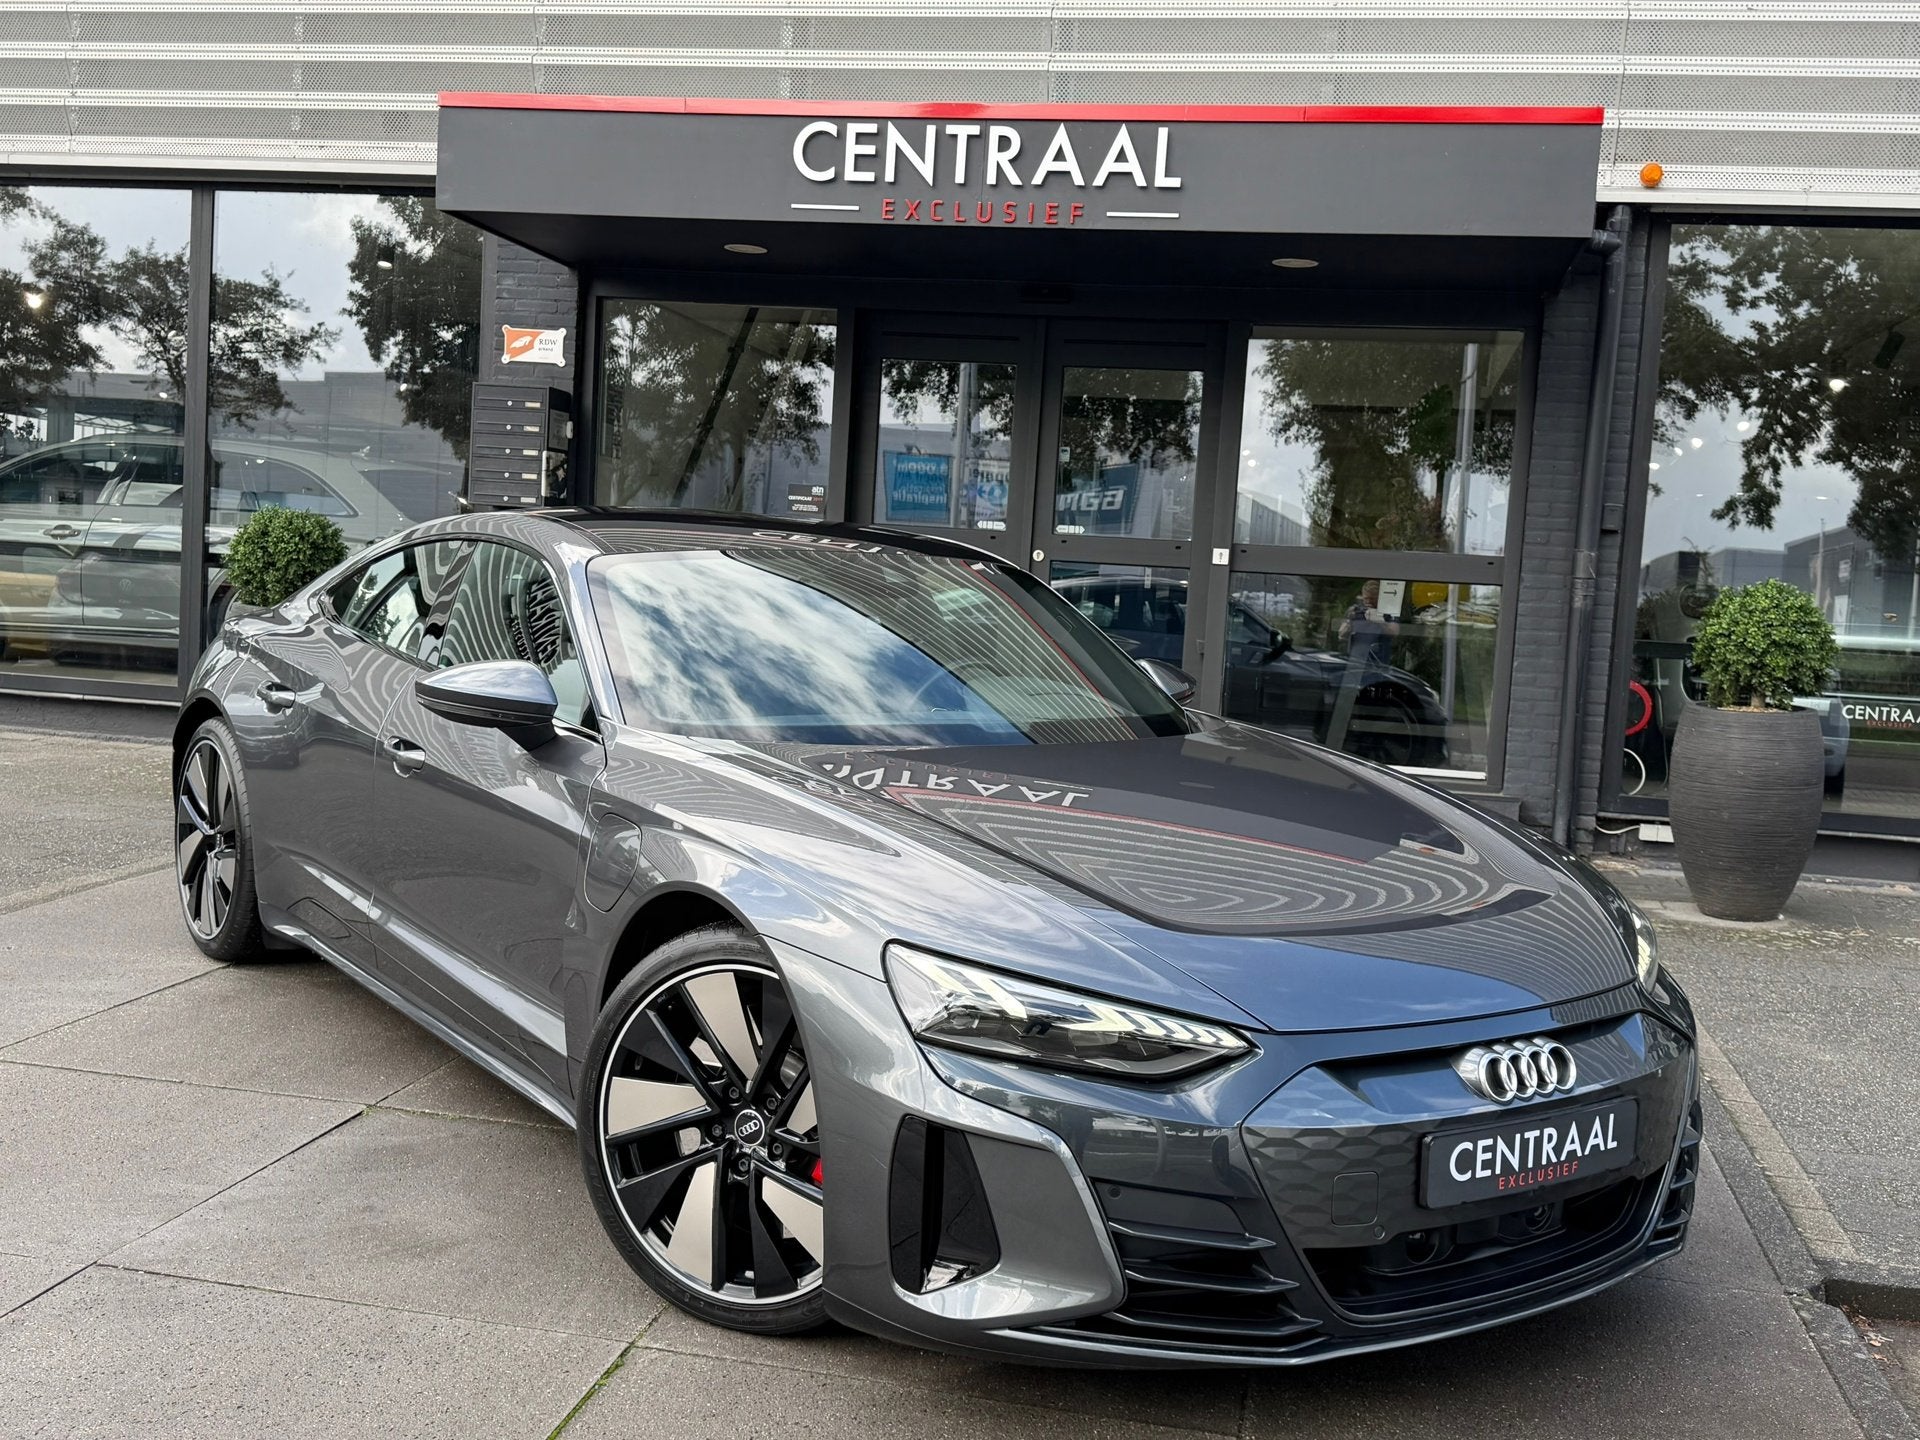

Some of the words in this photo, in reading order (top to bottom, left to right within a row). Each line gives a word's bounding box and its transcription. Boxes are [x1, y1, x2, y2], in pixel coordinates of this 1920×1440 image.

[792, 120, 1182, 188] CENTRAAL
[881, 198, 1085, 224] EXCLUSIEF
[538, 338, 558, 346] RDW
[1842, 704, 1920, 723] CENTRA
[1450, 1113, 1618, 1182] CENTRAAL
[1498, 1161, 1579, 1190] EXCLUSIEF
